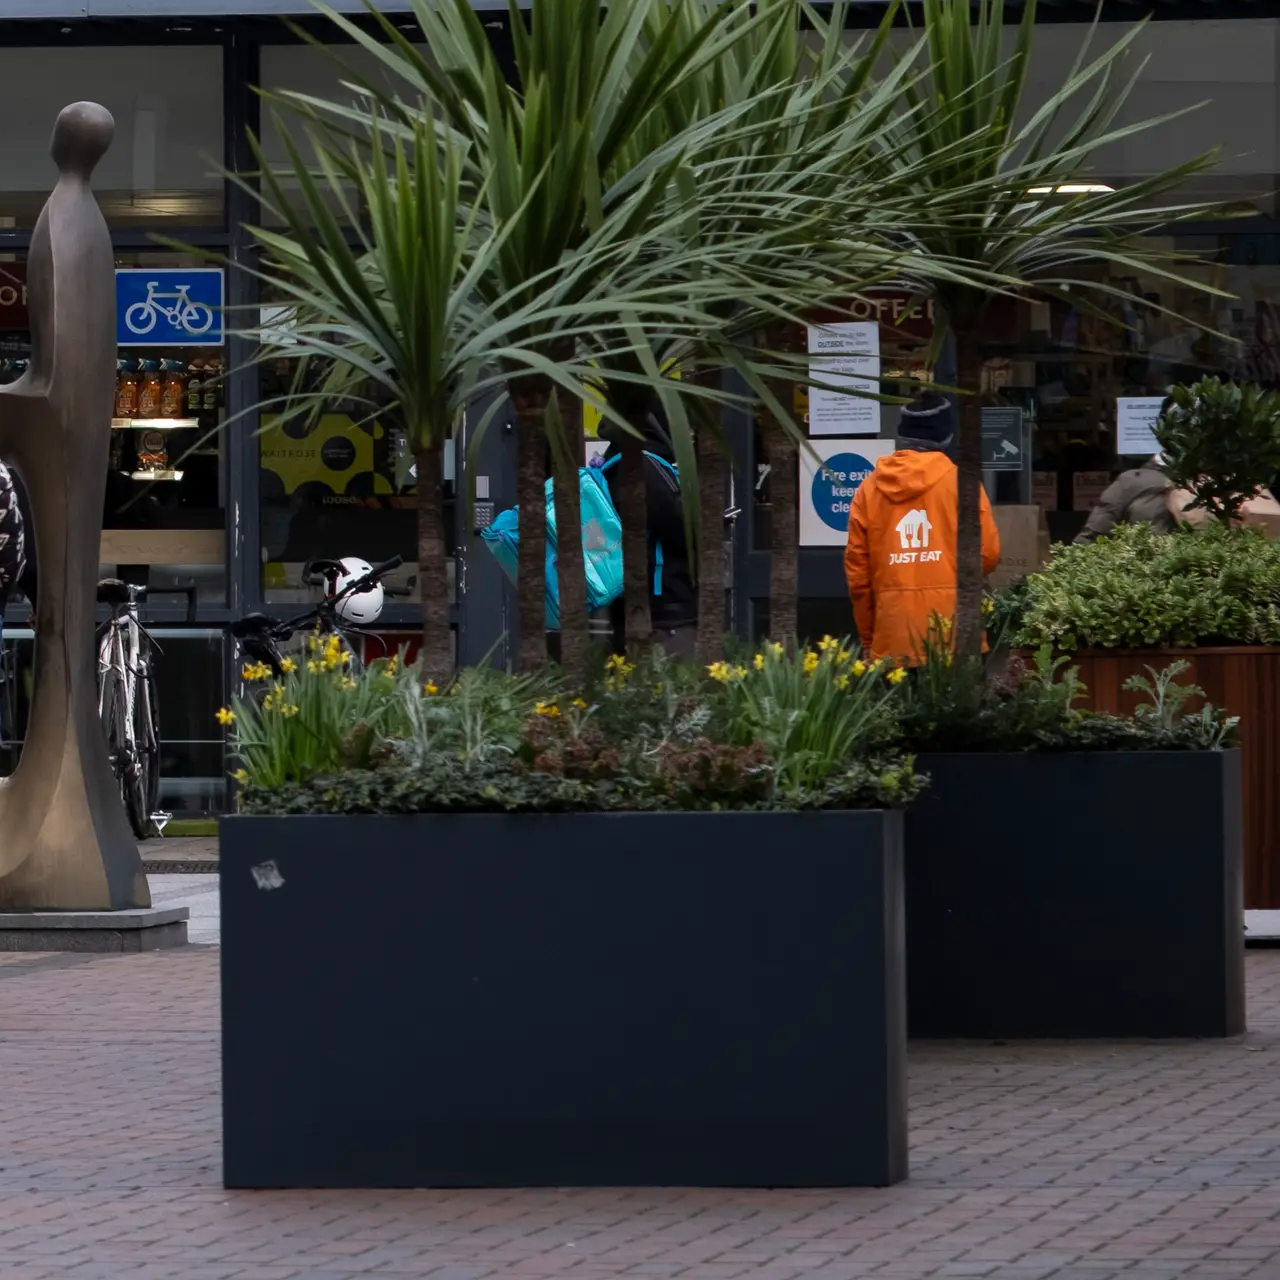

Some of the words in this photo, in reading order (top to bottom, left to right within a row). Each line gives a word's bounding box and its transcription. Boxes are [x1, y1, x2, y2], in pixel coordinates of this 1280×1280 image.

[260, 449, 316, 458] WAITROSE
[831, 502, 850, 513] cle
[889, 552, 918, 565] JUST
[920, 550, 943, 562] EAT
